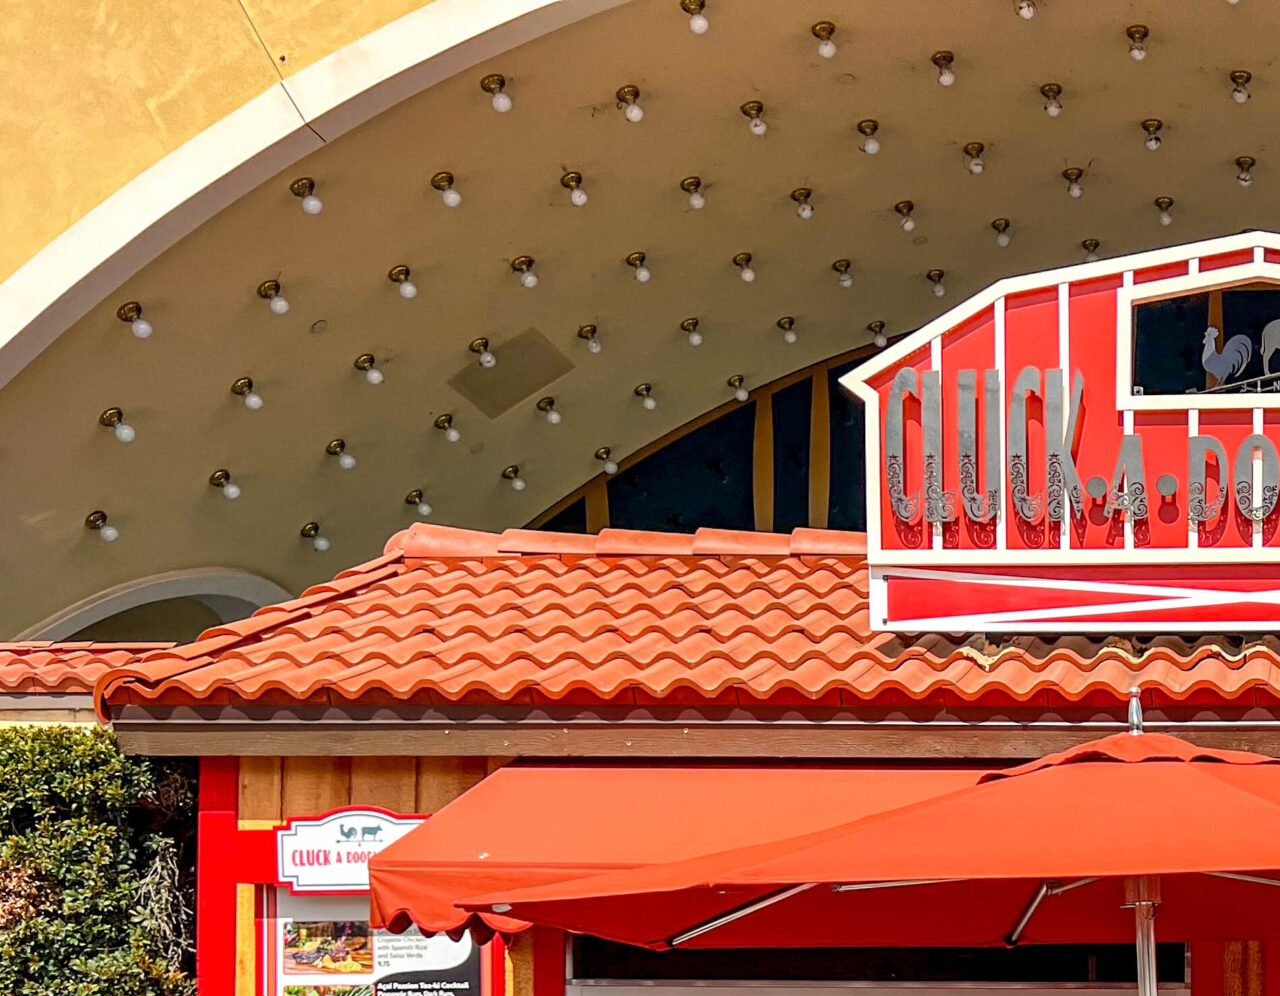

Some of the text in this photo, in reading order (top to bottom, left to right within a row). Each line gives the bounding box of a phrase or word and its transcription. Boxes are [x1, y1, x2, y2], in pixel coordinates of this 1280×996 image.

[885, 366, 1085, 524] CLUCK
[291, 849, 331, 866] CLUCK
[336, 851, 342, 863] A
